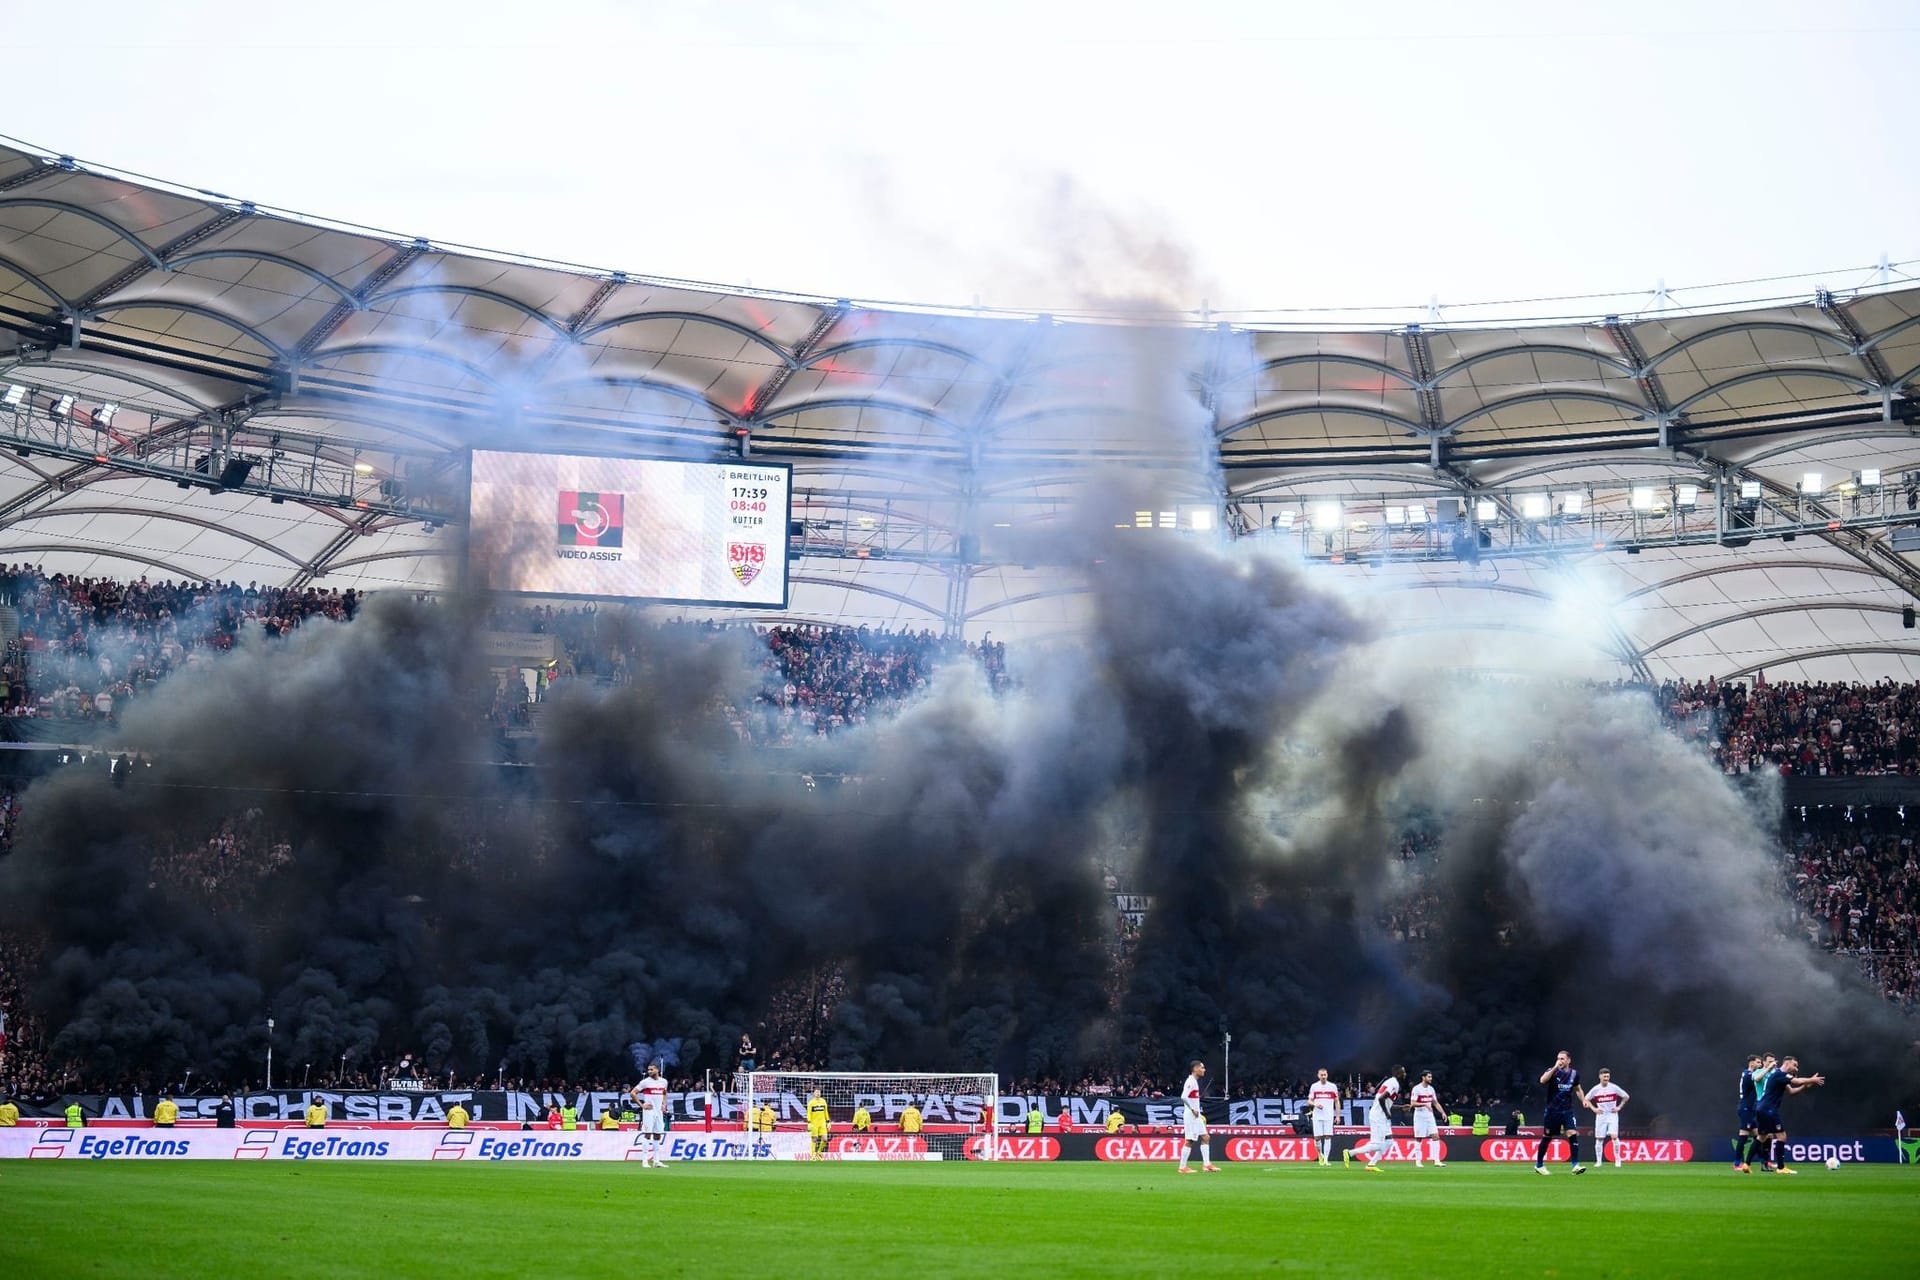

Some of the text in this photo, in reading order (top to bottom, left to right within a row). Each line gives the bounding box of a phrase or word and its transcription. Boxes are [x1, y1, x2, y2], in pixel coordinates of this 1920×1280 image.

[729, 471, 781, 482] BREITLING
[732, 487, 768, 499] 17:39
[730, 500, 767, 512] 08:40
[733, 516, 763, 525] KUTTER
[556, 550, 623, 561] VIDEO ASSIST
[79, 1135, 190, 1160] EgeTrans
[282, 1136, 390, 1160] EgeTrans
[478, 1137, 584, 1161] EgeTrans
[670, 1138, 772, 1161] EgeTrans
[794, 1152, 842, 1161] WINMAX
